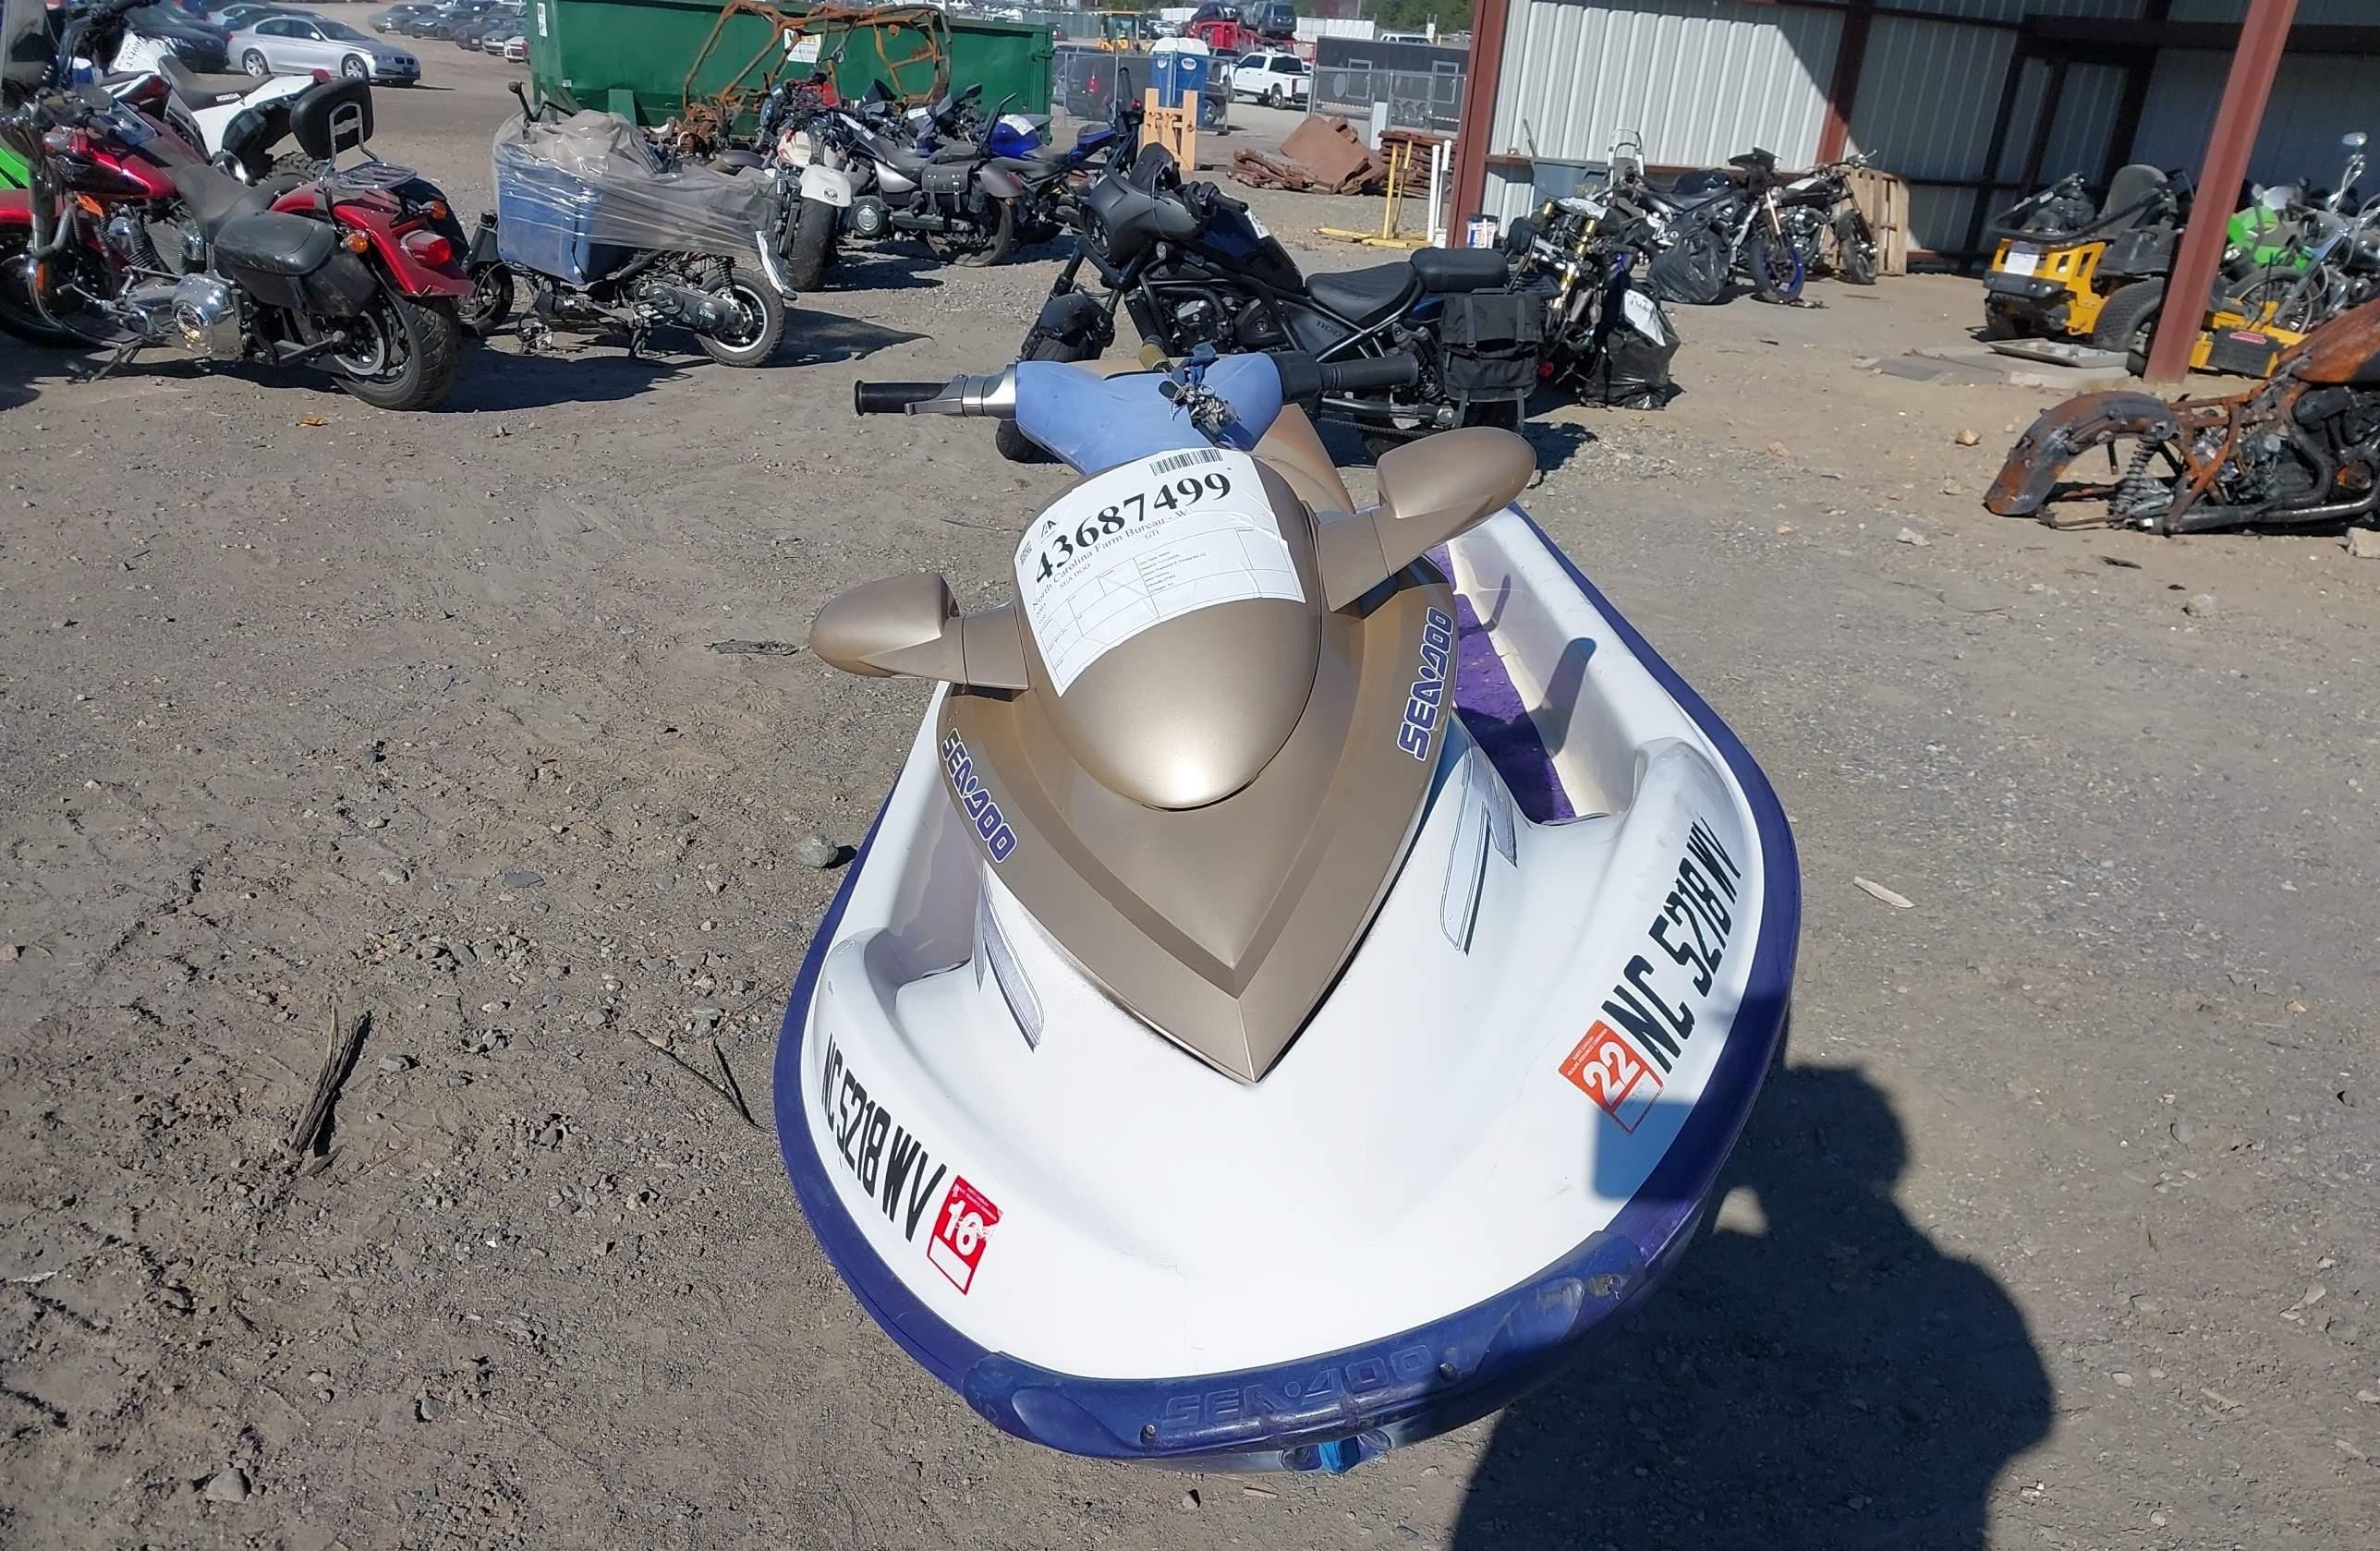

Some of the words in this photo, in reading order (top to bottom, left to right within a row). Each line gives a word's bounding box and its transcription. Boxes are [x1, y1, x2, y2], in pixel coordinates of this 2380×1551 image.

[1032, 583, 1052, 611] North
[1053, 551, 1093, 583] Carolina
[1094, 535, 1123, 552] Farm
[1125, 518, 1165, 537] Bureau
[1036, 472, 1231, 585] 43687499
[1686, 817, 1742, 904] WV
[1648, 857, 1732, 997] 5218
[1601, 954, 1695, 1074] NC
[1583, 1041, 1641, 1107] 22
[821, 1032, 843, 1133] NC
[836, 1068, 892, 1198] 5218
[882, 1125, 947, 1242] WV
